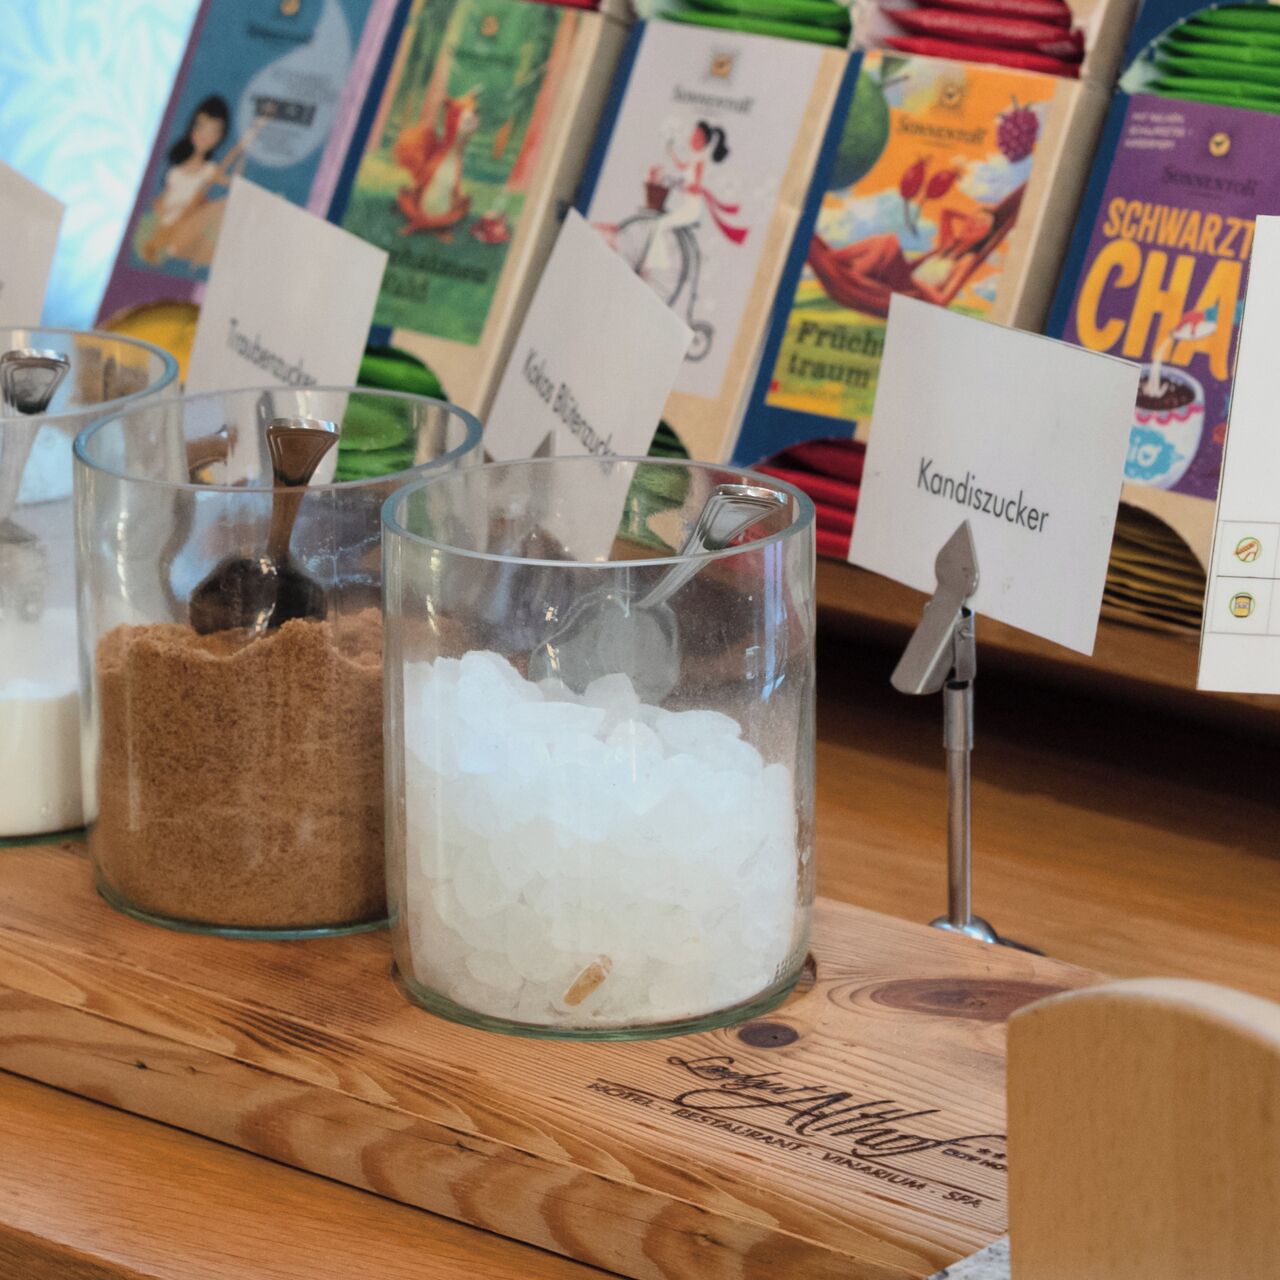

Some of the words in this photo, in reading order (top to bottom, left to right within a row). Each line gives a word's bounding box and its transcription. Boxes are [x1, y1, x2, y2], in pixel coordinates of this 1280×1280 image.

[1102, 196, 1257, 261] SCHWARZT
[1076, 237, 1244, 382] CHA
[787, 351, 871, 390] traum
[917, 455, 1050, 533] Kandiszucker
[586, 1082, 655, 1108] HOTEL
[670, 1107, 811, 1152] RESTAURANT
[821, 1151, 927, 1190] VINARIUM
[941, 1190, 985, 1209] SPA
